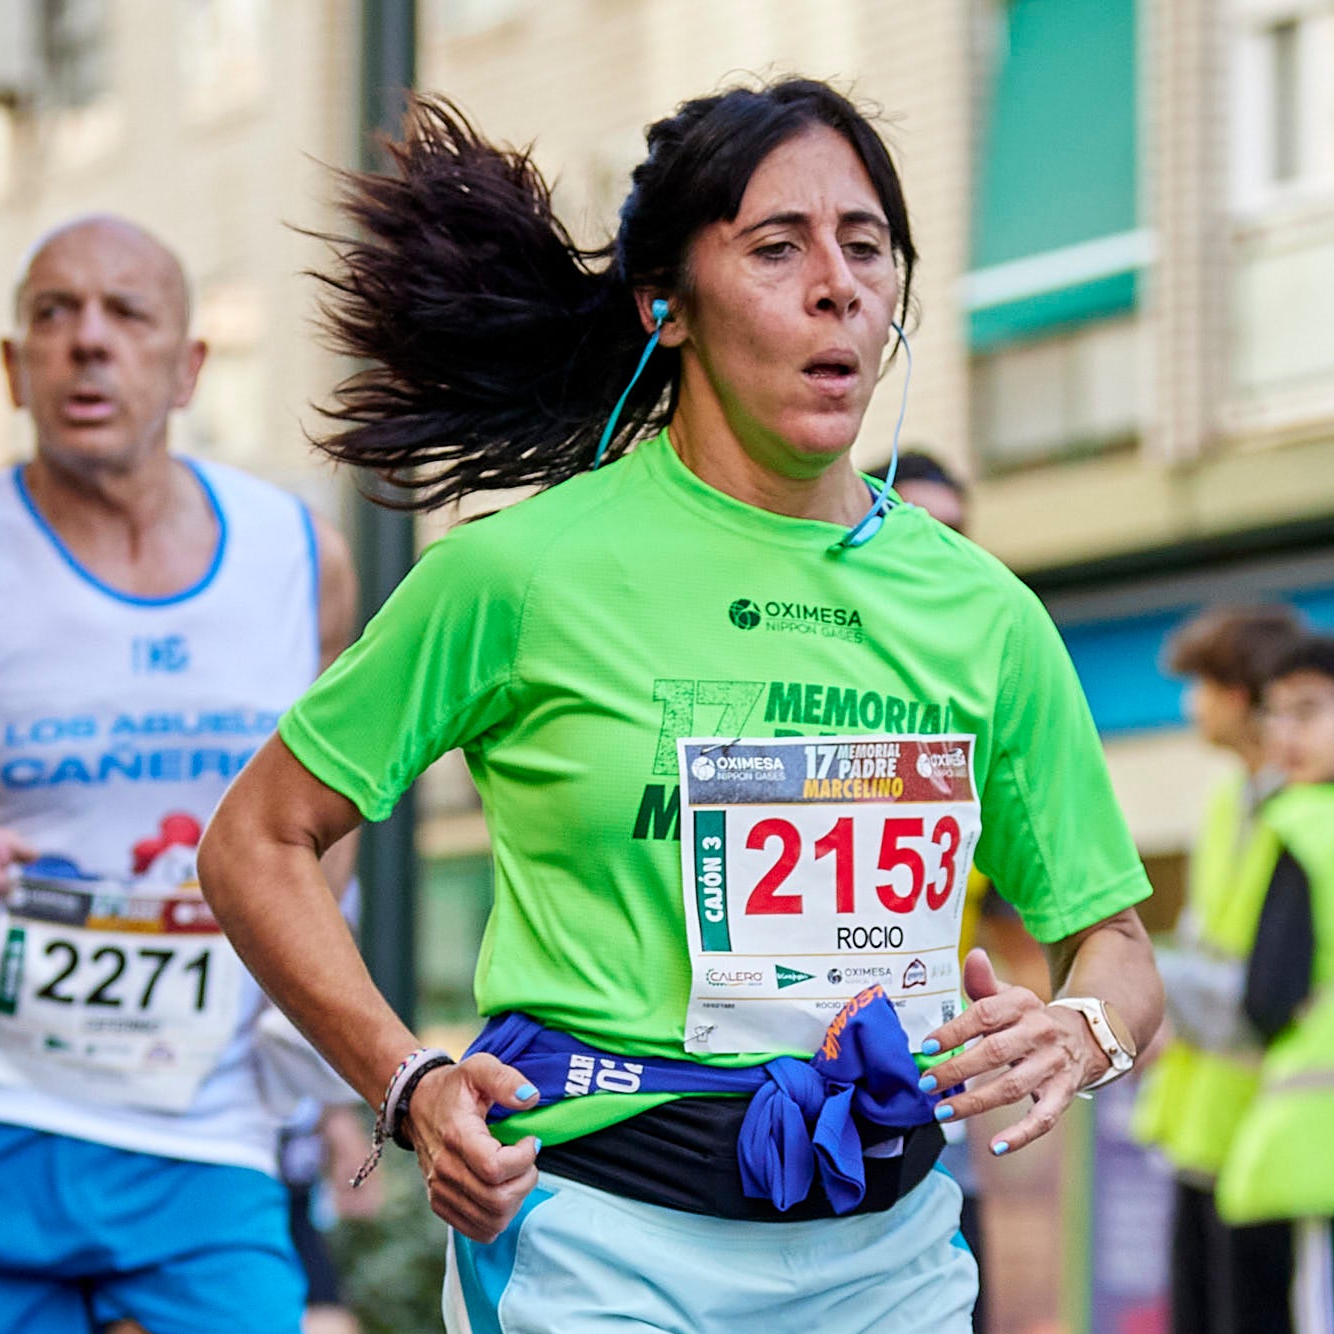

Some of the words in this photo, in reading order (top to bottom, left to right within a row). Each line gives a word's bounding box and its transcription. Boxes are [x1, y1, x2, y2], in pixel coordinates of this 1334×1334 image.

[765, 600, 863, 628] OXIMESA
[766, 621, 817, 637] NIPPON
[820, 627, 866, 645] GASES
[652, 678, 766, 776] 17
[804, 744, 840, 780] 17
[837, 743, 901, 759] MEMORIAL
[716, 756, 785, 771] OXIMESA
[839, 758, 897, 779] PADRE
[717, 771, 753, 781] NIPPON
[755, 771, 786, 781] GASES
[803, 777, 904, 799] MARCELINO
[702, 836, 722, 850] 3
[745, 815, 961, 915] 2153
[699, 856, 724, 923] CAJÓN
[837, 926, 904, 951] ROCIO
[36, 939, 214, 1013] 2271
[709, 971, 763, 982] CALERO
[844, 967, 892, 977] OXIMESA
